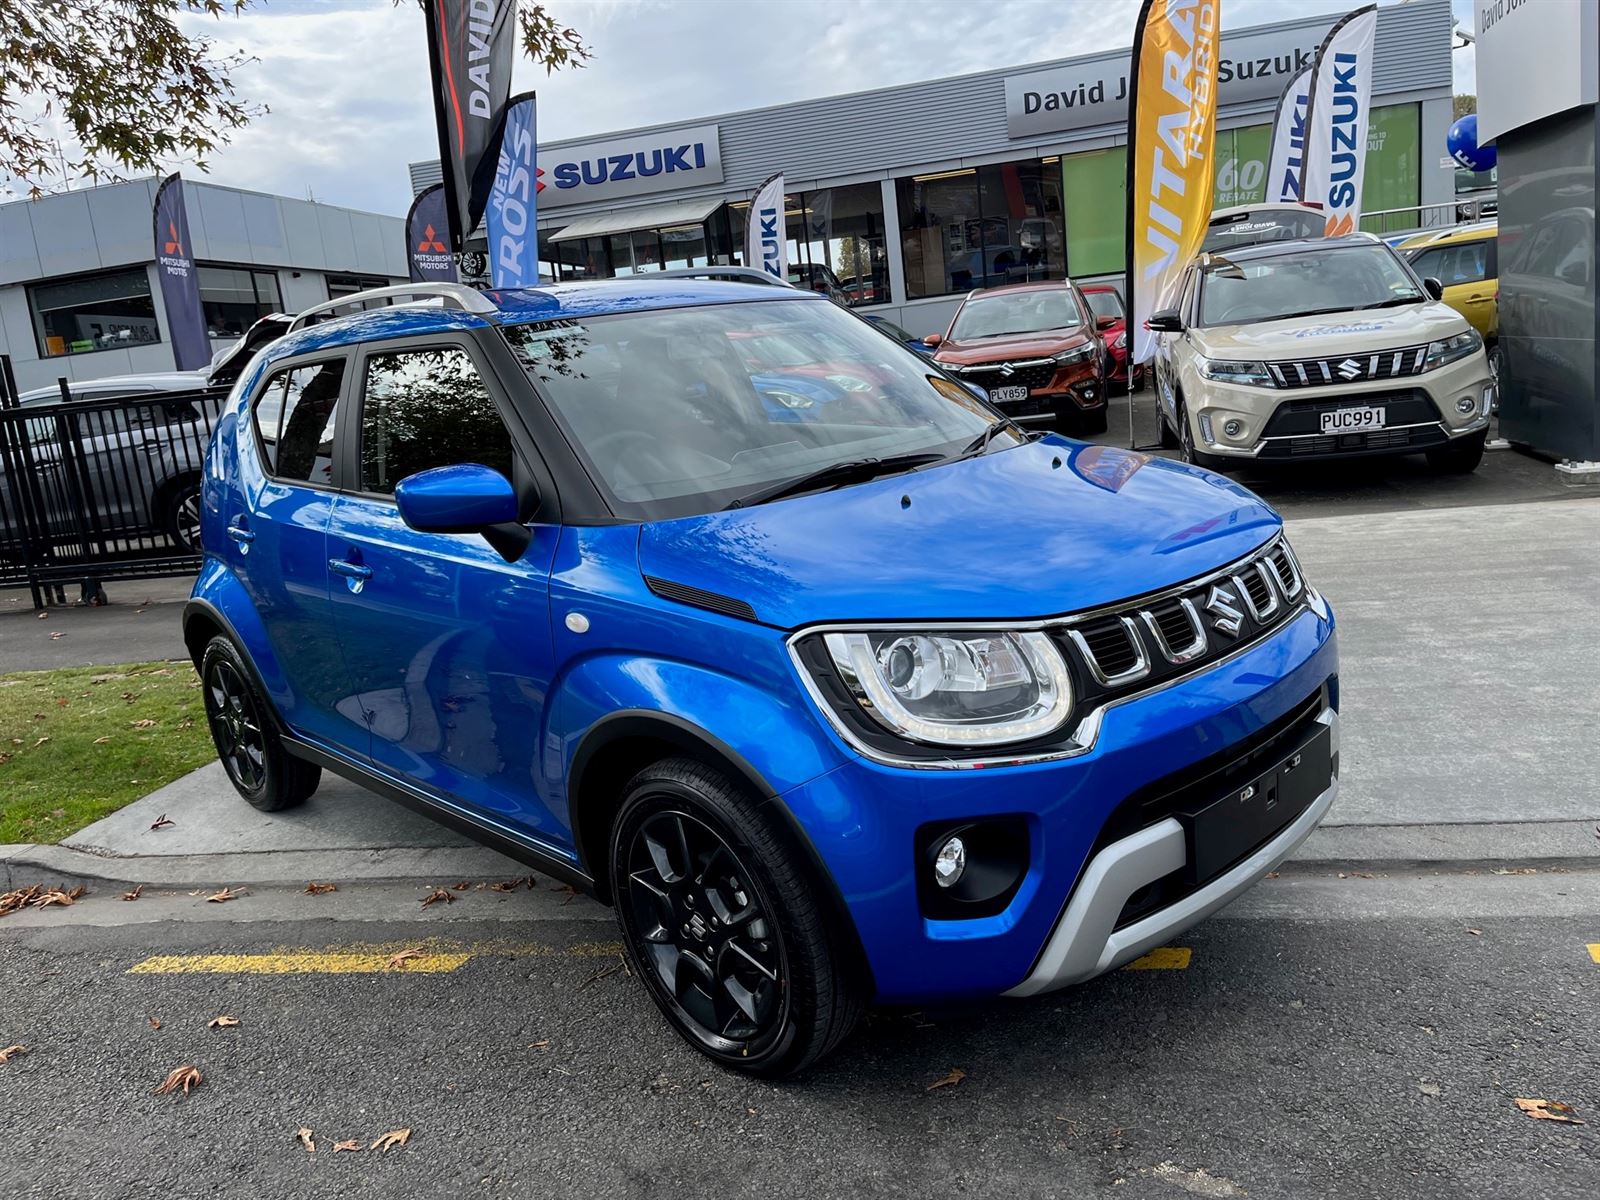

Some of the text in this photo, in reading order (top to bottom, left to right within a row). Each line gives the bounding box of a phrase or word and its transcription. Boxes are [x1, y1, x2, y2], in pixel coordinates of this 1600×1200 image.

[1481, 0, 1504, 34] David
[468, 0, 496, 119] DAVID
[1188, 2, 1214, 160] HYBRID
[1023, 80, 1105, 115] David
[1144, 0, 1199, 282] VITARA
[1280, 94, 1308, 203] ZUKI
[1328, 52, 1358, 209] SUZUKI
[492, 149, 512, 211] NEW
[553, 142, 706, 189] SUZUKI
[420, 262, 449, 270] MOTORS
[991, 388, 1026, 400] PLY859
[1322, 409, 1382, 430] PUC991
